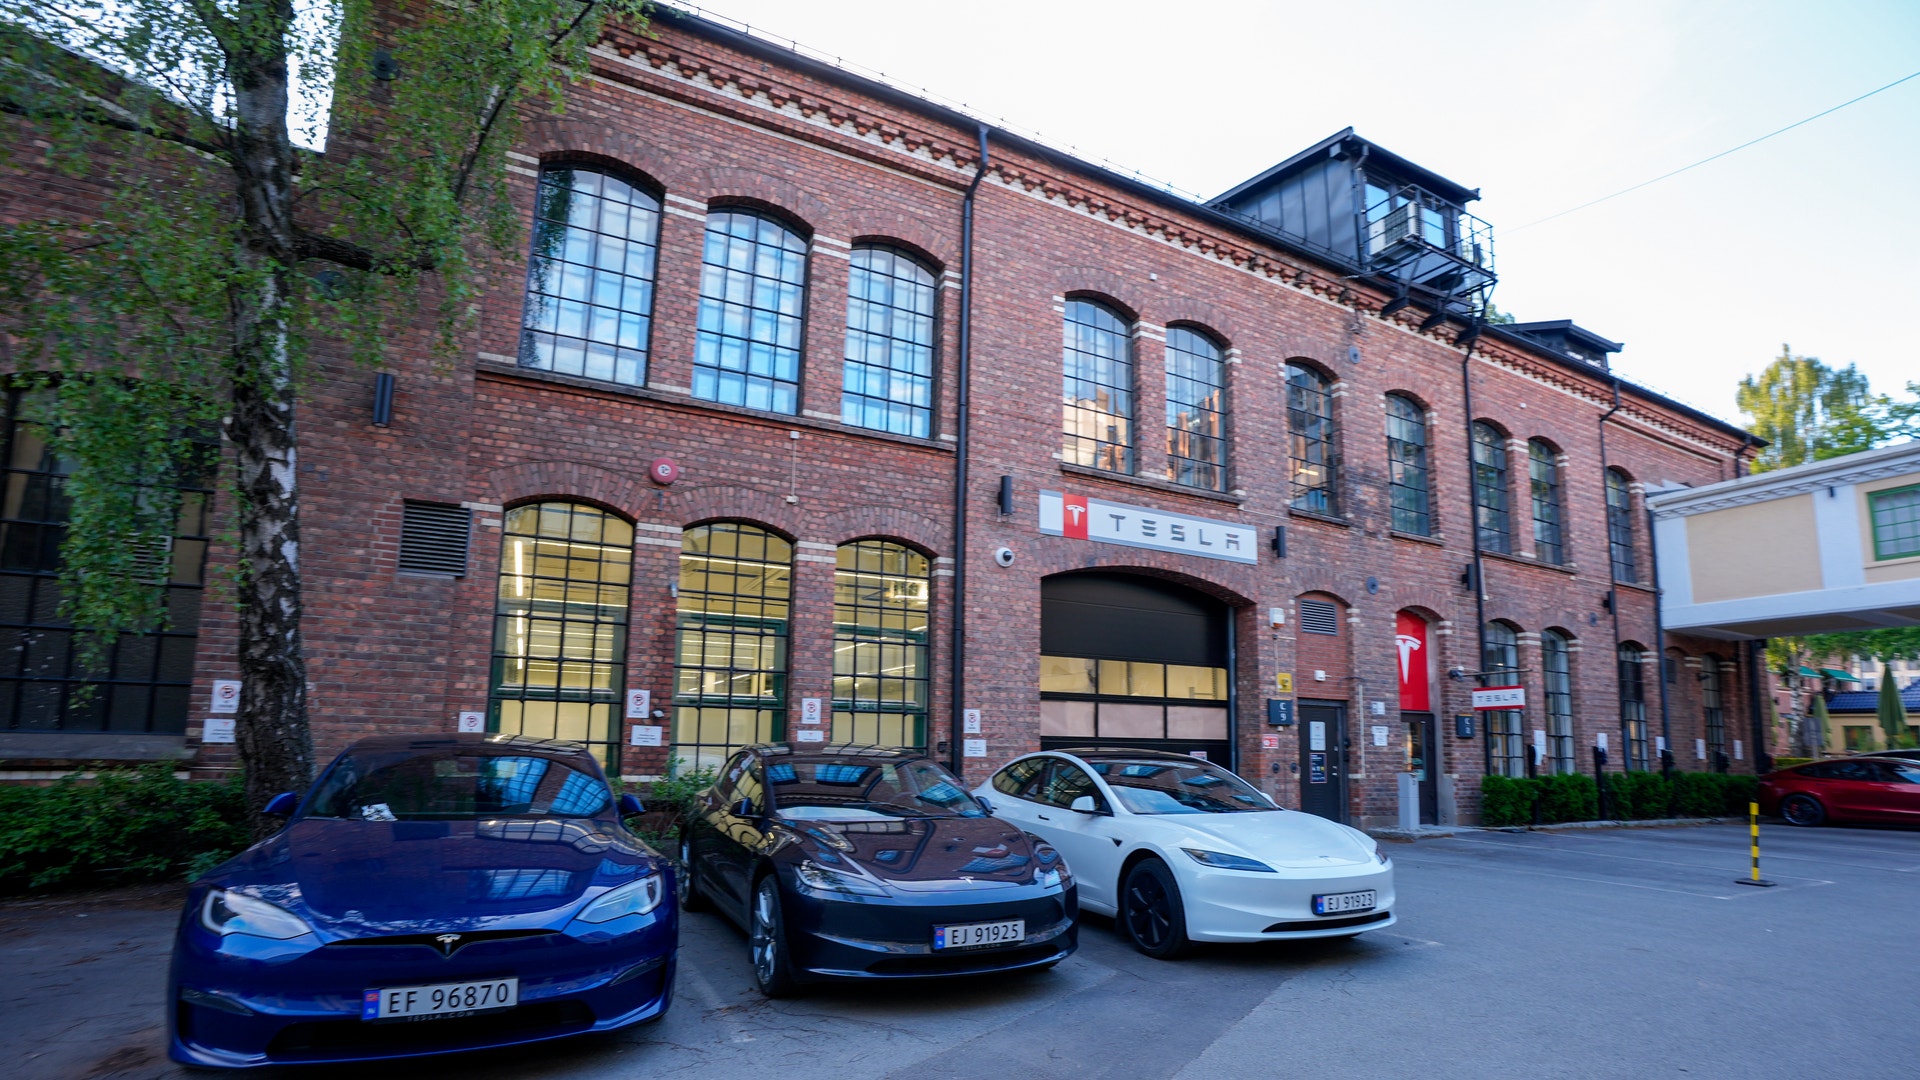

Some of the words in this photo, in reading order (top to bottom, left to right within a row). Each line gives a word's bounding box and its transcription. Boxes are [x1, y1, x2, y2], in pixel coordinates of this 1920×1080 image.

[1108, 513, 1240, 551] TESLA
[1279, 702, 1287, 710] C
[1476, 693, 1519, 703] TESLA
[1280, 713, 1287, 721] 9
[1328, 897, 1340, 911] EJ
[1343, 893, 1373, 909] 91923
[951, 928, 968, 945] EJ
[975, 923, 1019, 943] 91925
[388, 990, 418, 1014] EF
[432, 982, 509, 1010] 96870
